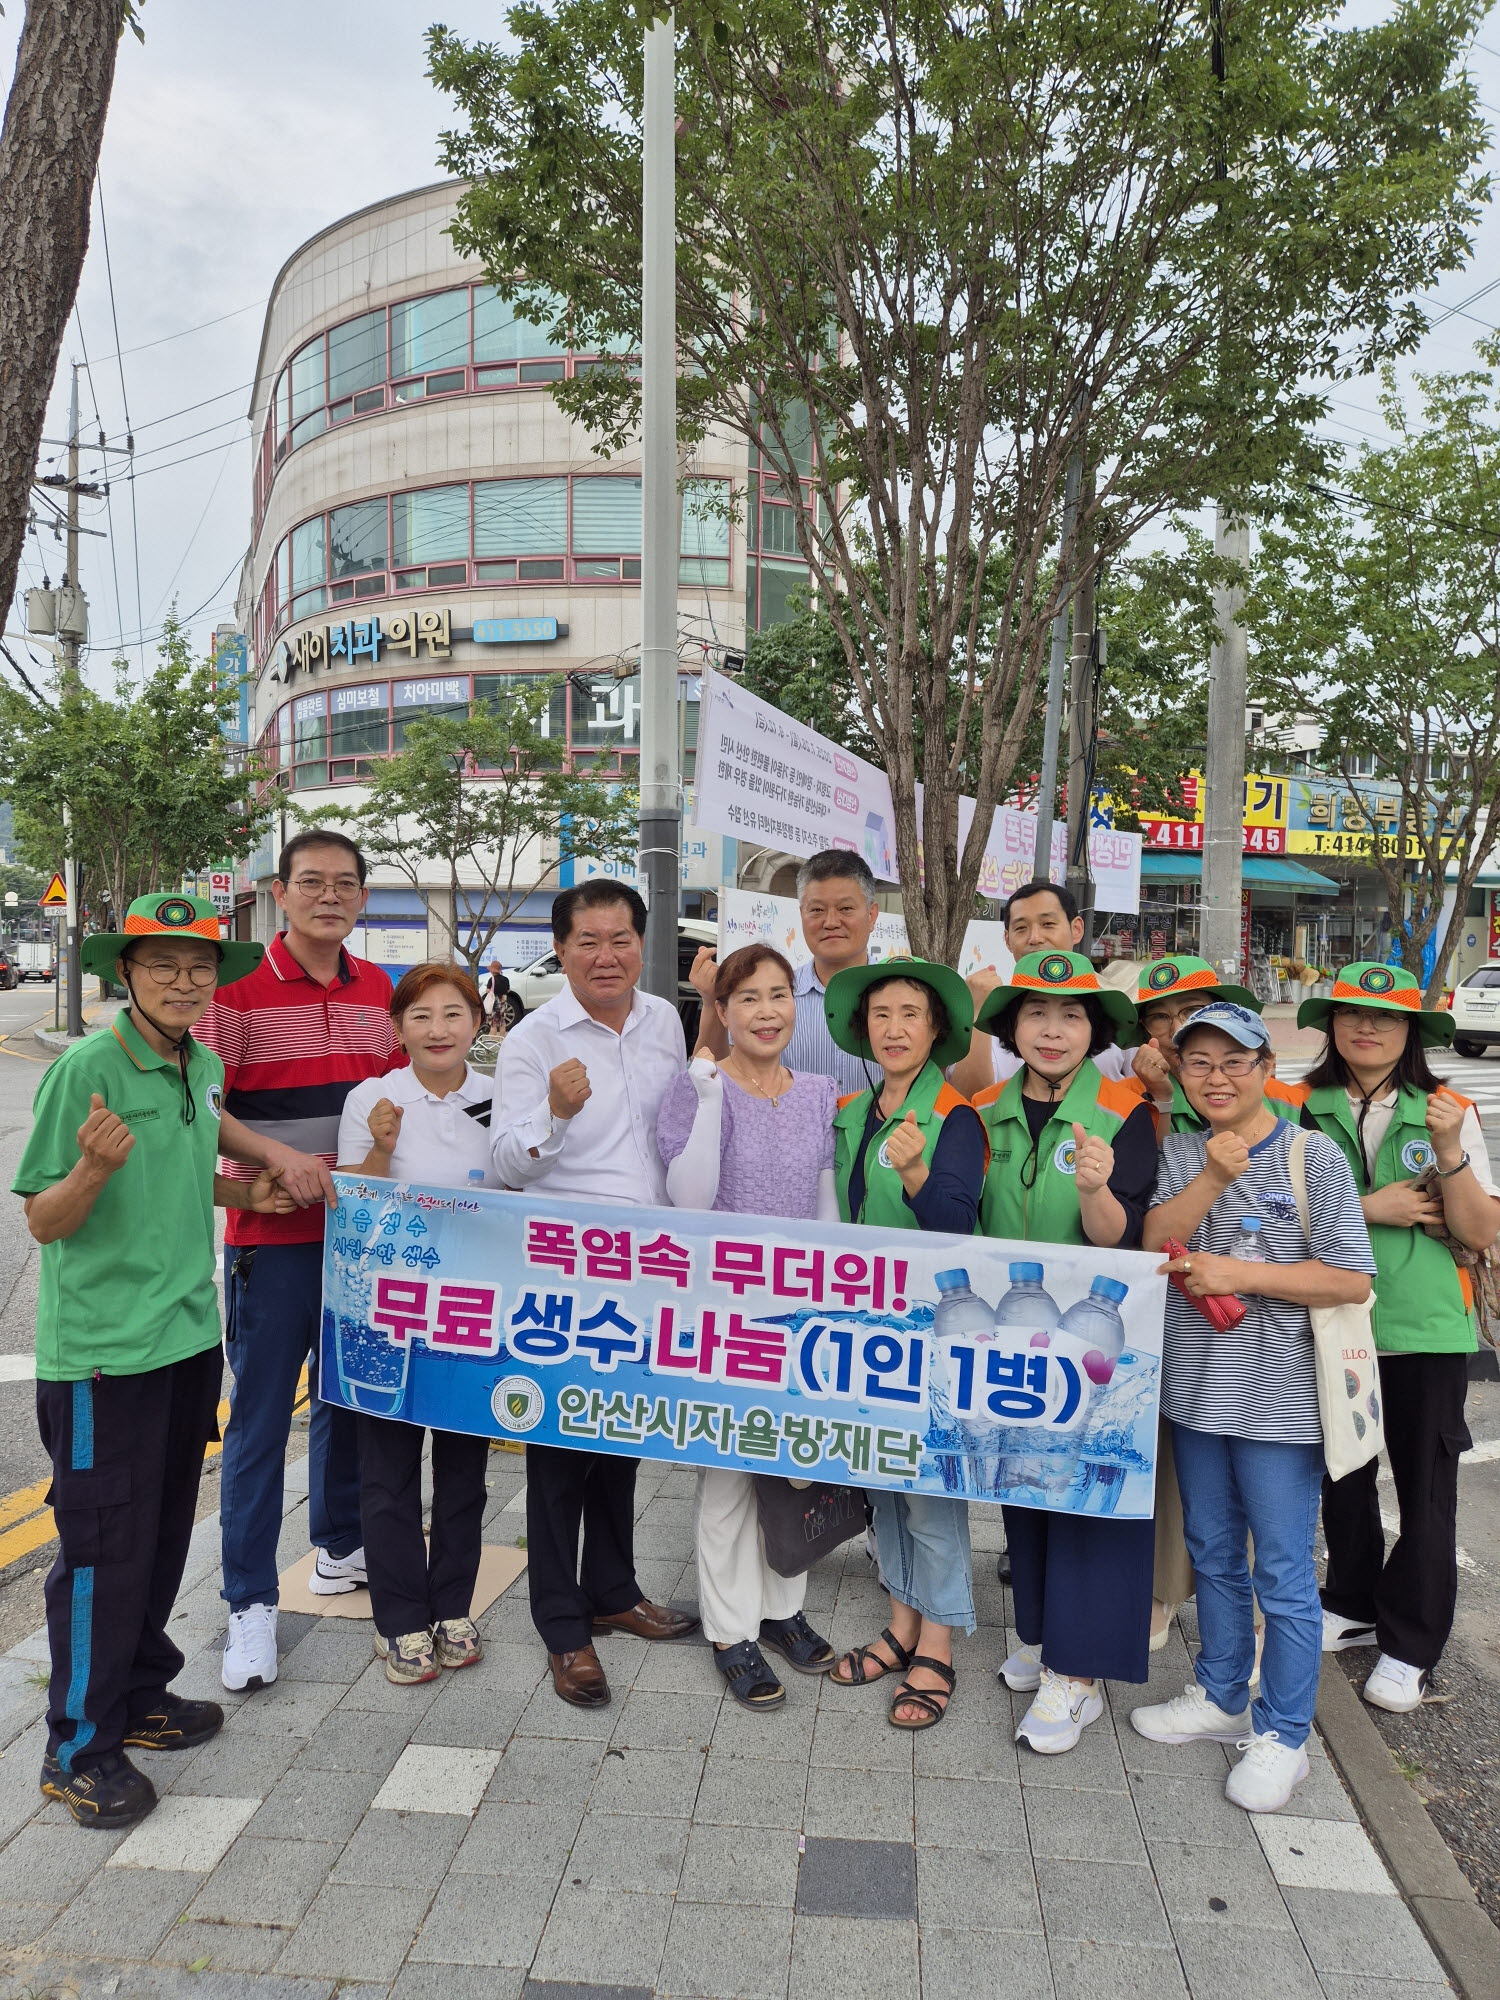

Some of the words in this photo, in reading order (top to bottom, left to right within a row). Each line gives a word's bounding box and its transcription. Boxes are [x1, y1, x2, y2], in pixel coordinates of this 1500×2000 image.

[475, 622, 553, 639] 411-5550
[337, 688, 380, 711] 심미보철
[403, 681, 460, 702] 치아미백
[212, 875, 230, 893] 약
[1113, 914, 1138, 929] 부성
[1147, 915, 1172, 929] 부성
[458, 1202, 482, 1213] 안산
[402, 1245, 440, 1269] 생수
[528, 1222, 690, 1287] 폭염속
[713, 1241, 908, 1311] 무더위!
[375, 1278, 495, 1348] 무료
[511, 1292, 637, 1365] 생수
[657, 1308, 787, 1383] 나눔
[800, 1325, 924, 1404] (1인
[950, 1345, 1082, 1424] 1병)
[1342, 1349, 1370, 1360] ELLO,
[561, 1388, 924, 1478] 안산시자율방재단
